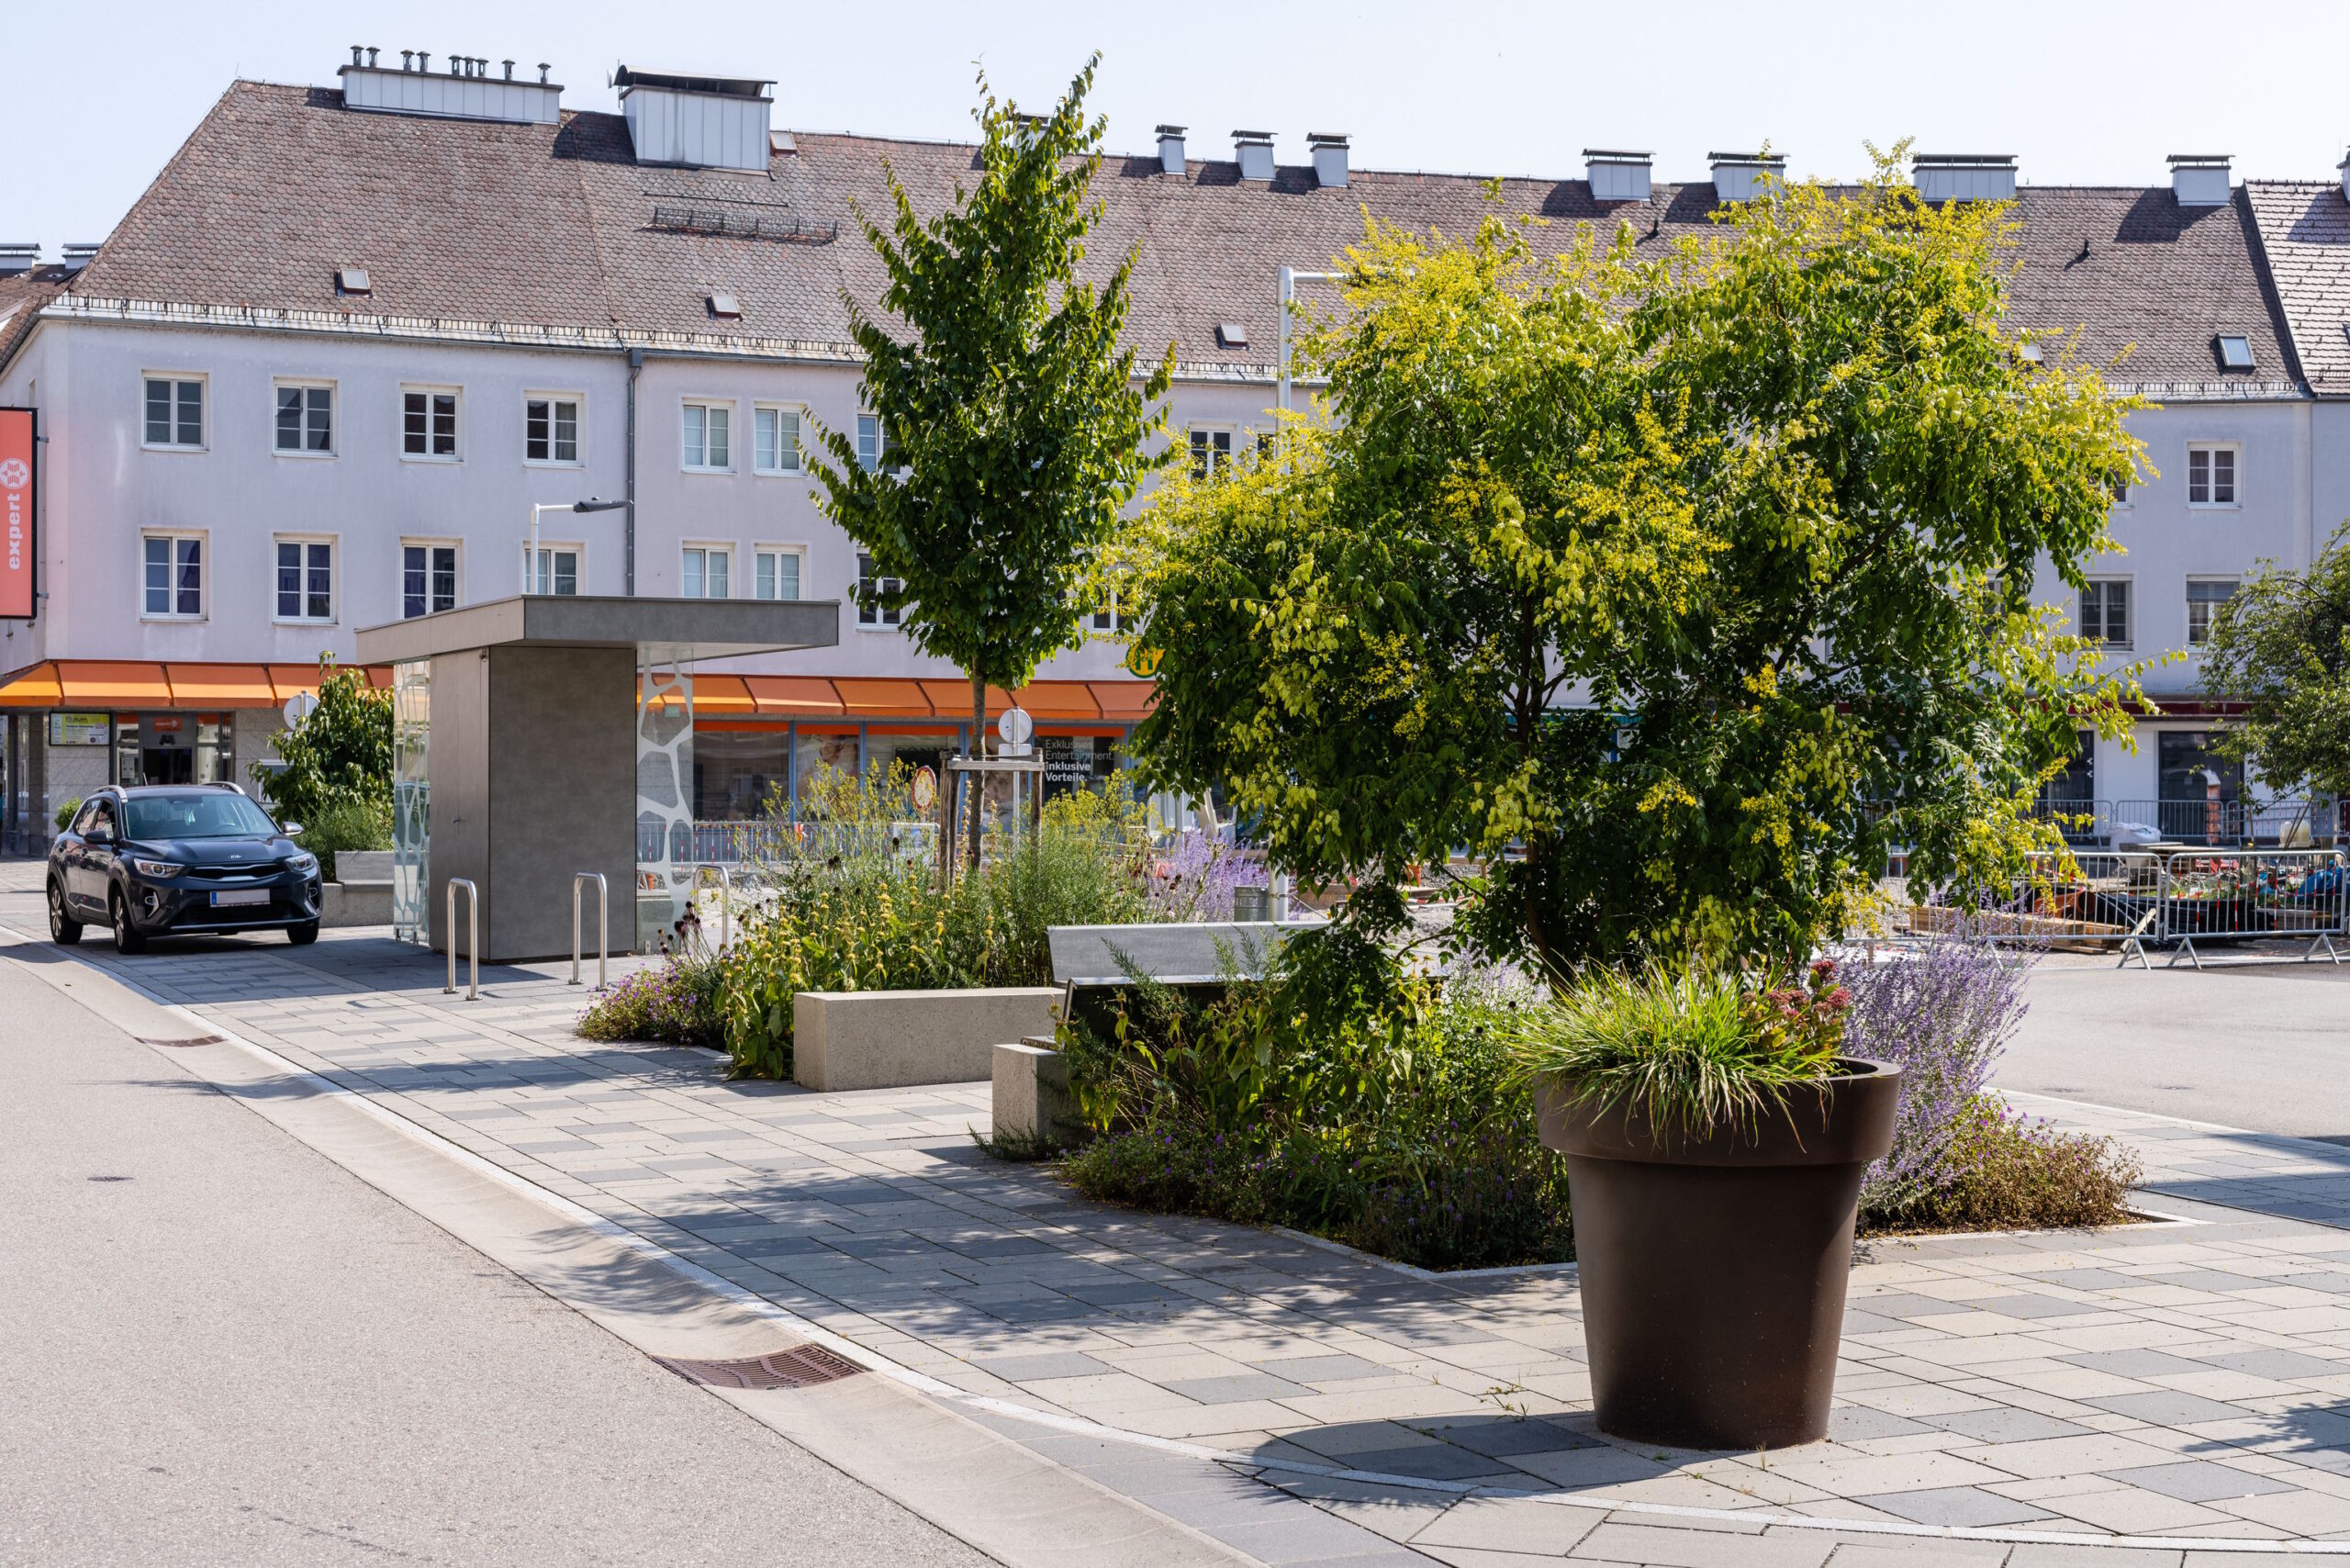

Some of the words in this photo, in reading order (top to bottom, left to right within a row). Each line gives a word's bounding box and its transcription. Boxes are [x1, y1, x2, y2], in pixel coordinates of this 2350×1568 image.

[7, 493, 23, 570] expert
[1046, 739, 1093, 749] Exklusives
[1046, 750, 1114, 760] Entertainment.
[1046, 772, 1088, 781] Vorteile.
